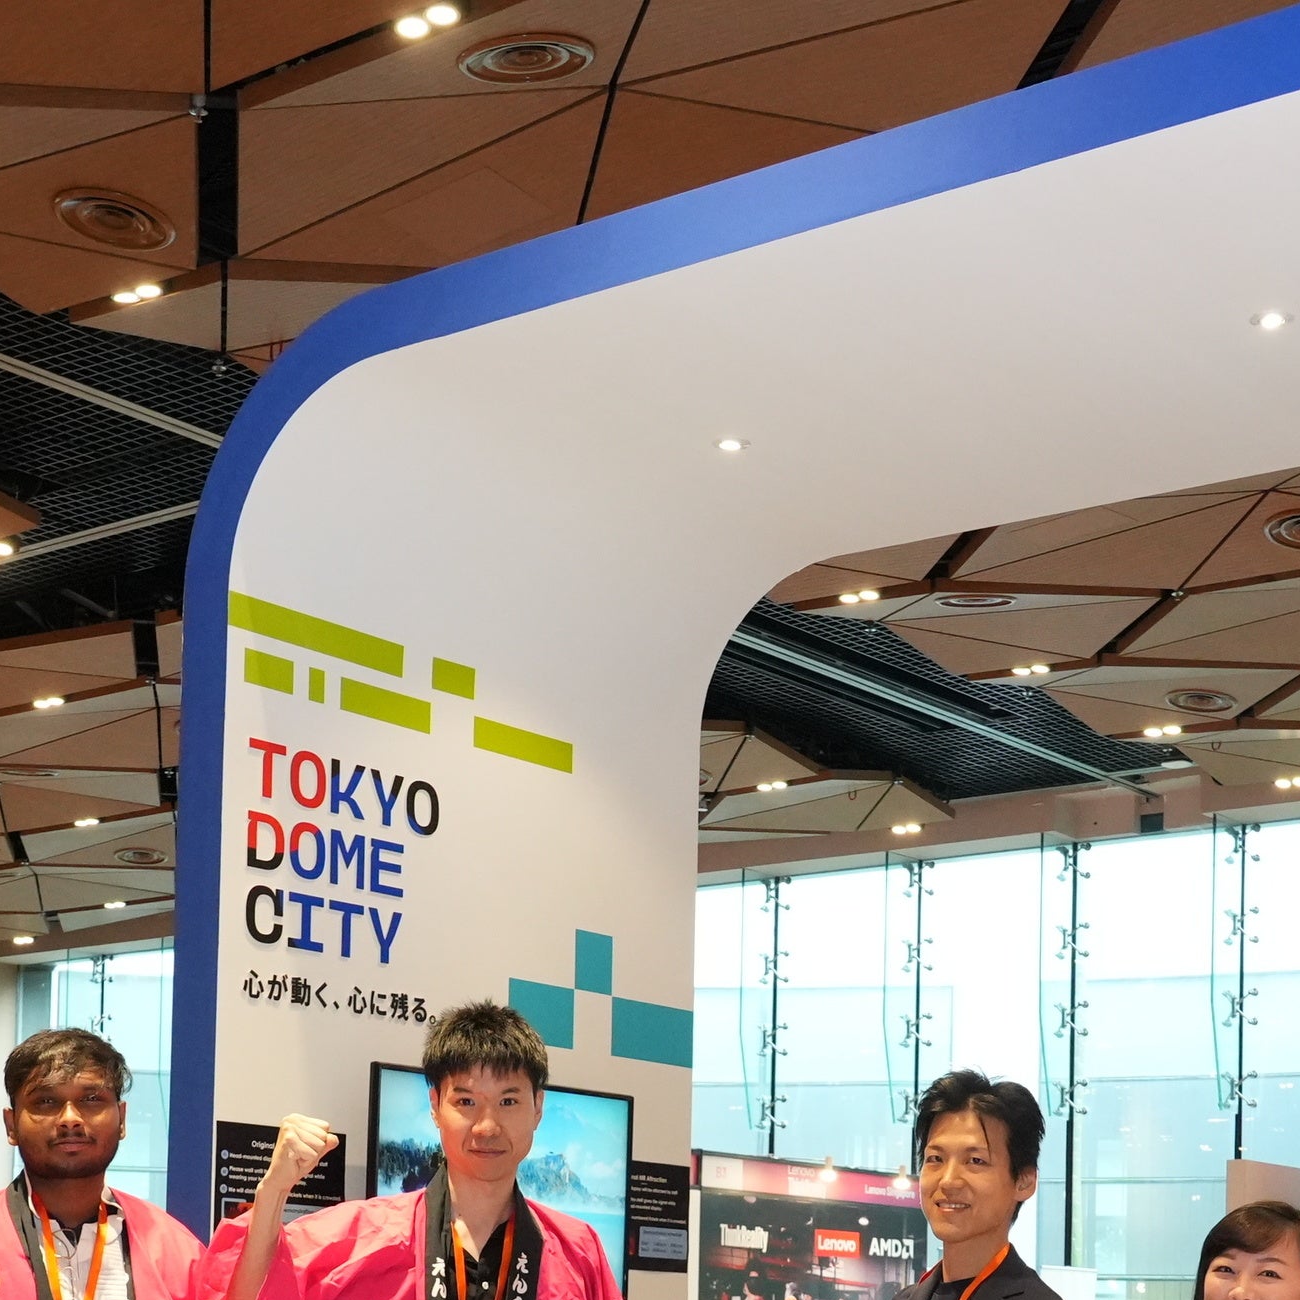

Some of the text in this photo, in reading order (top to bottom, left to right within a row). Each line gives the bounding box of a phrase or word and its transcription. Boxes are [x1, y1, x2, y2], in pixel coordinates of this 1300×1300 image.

[249, 737, 440, 836] TOKYO
[247, 810, 404, 898] DOME
[245, 885, 402, 965] CITY
[242, 969, 438, 1026] 心が動く、心に残る。
[720, 1223, 768, 1253] ThinkReality
[817, 1234, 857, 1252] Lenovo
[868, 1237, 903, 1257] AMD
